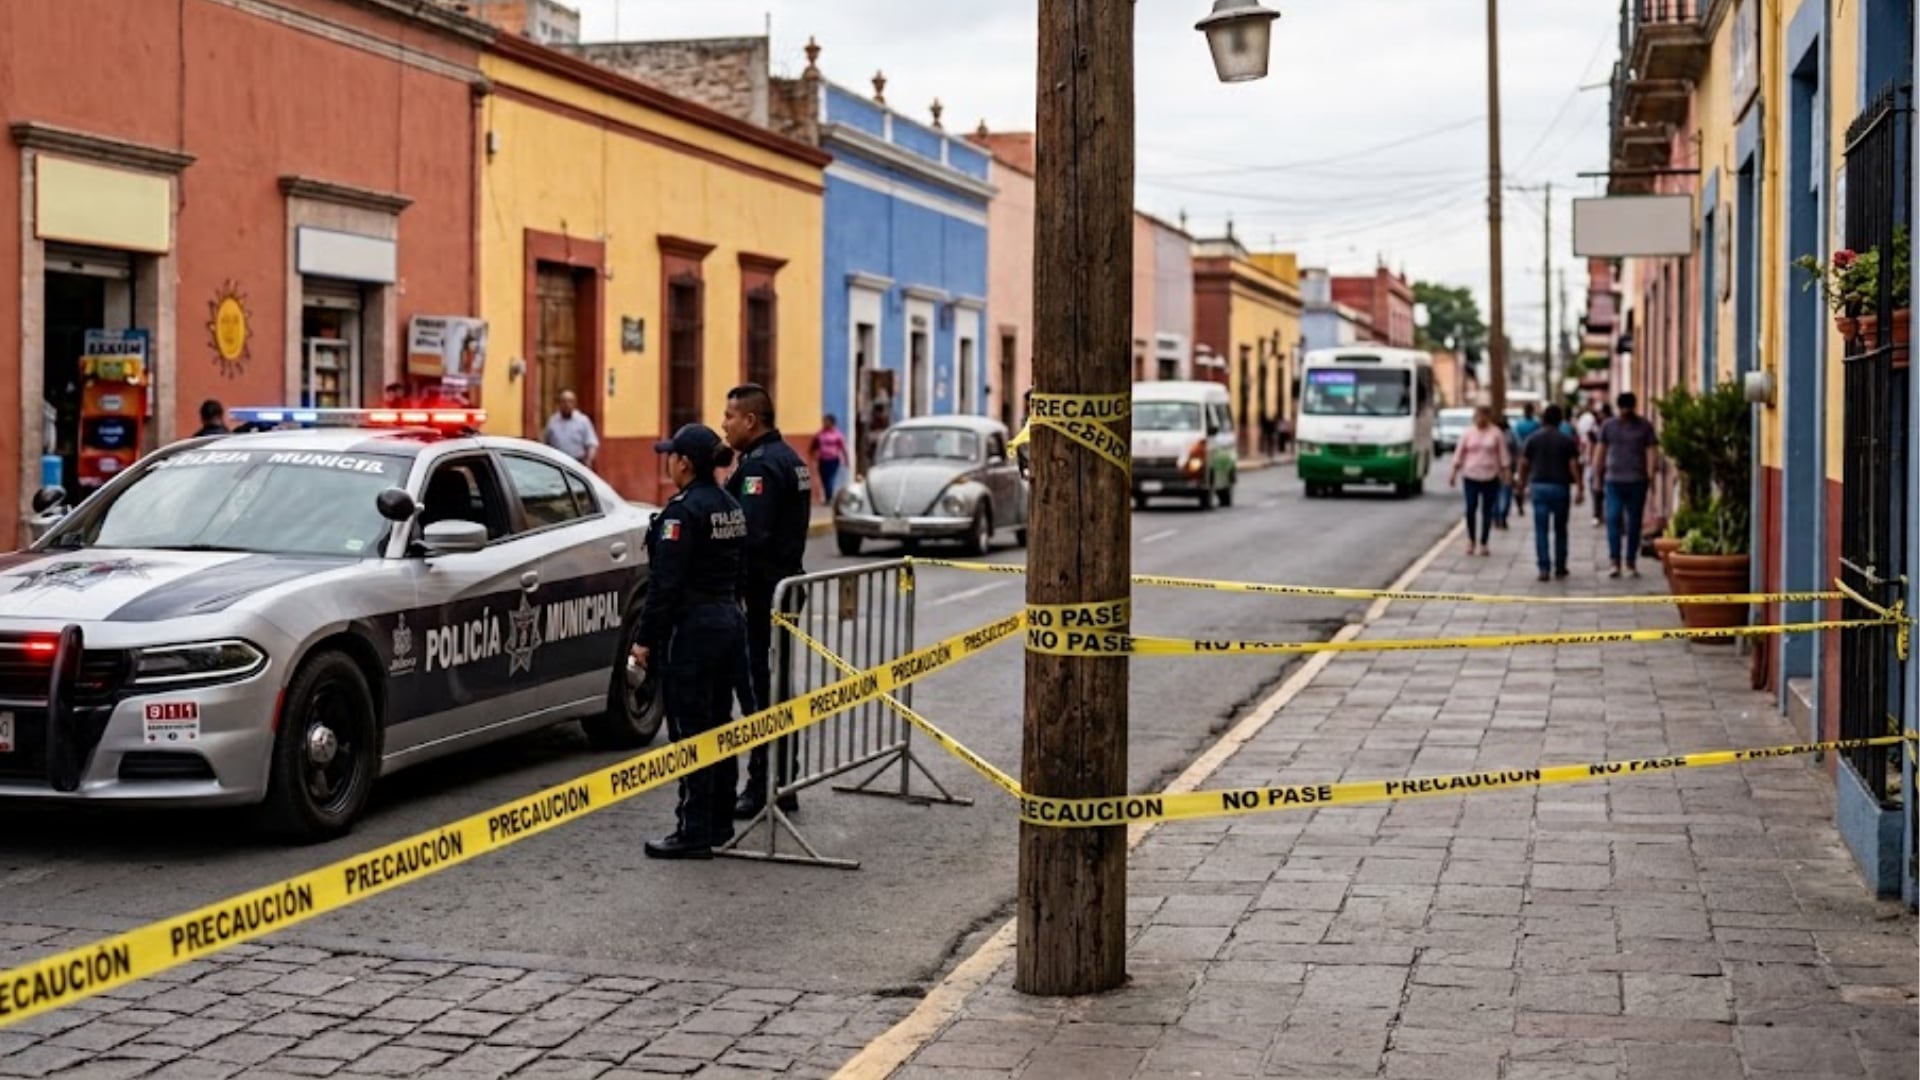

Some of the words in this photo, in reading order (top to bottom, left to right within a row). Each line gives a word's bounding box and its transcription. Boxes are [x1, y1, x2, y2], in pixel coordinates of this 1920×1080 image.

[1061, 604, 1122, 627] PASE
[425, 606, 501, 672] POLICÍA
[546, 591, 622, 643] MUNICIPAL
[1028, 629, 1058, 649] NO
[1222, 789, 1259, 810] NO
[1268, 784, 1333, 806] PASE
[170, 883, 313, 957] PRECAUCIÓN
[344, 829, 464, 894] PRECAUCIÓN
